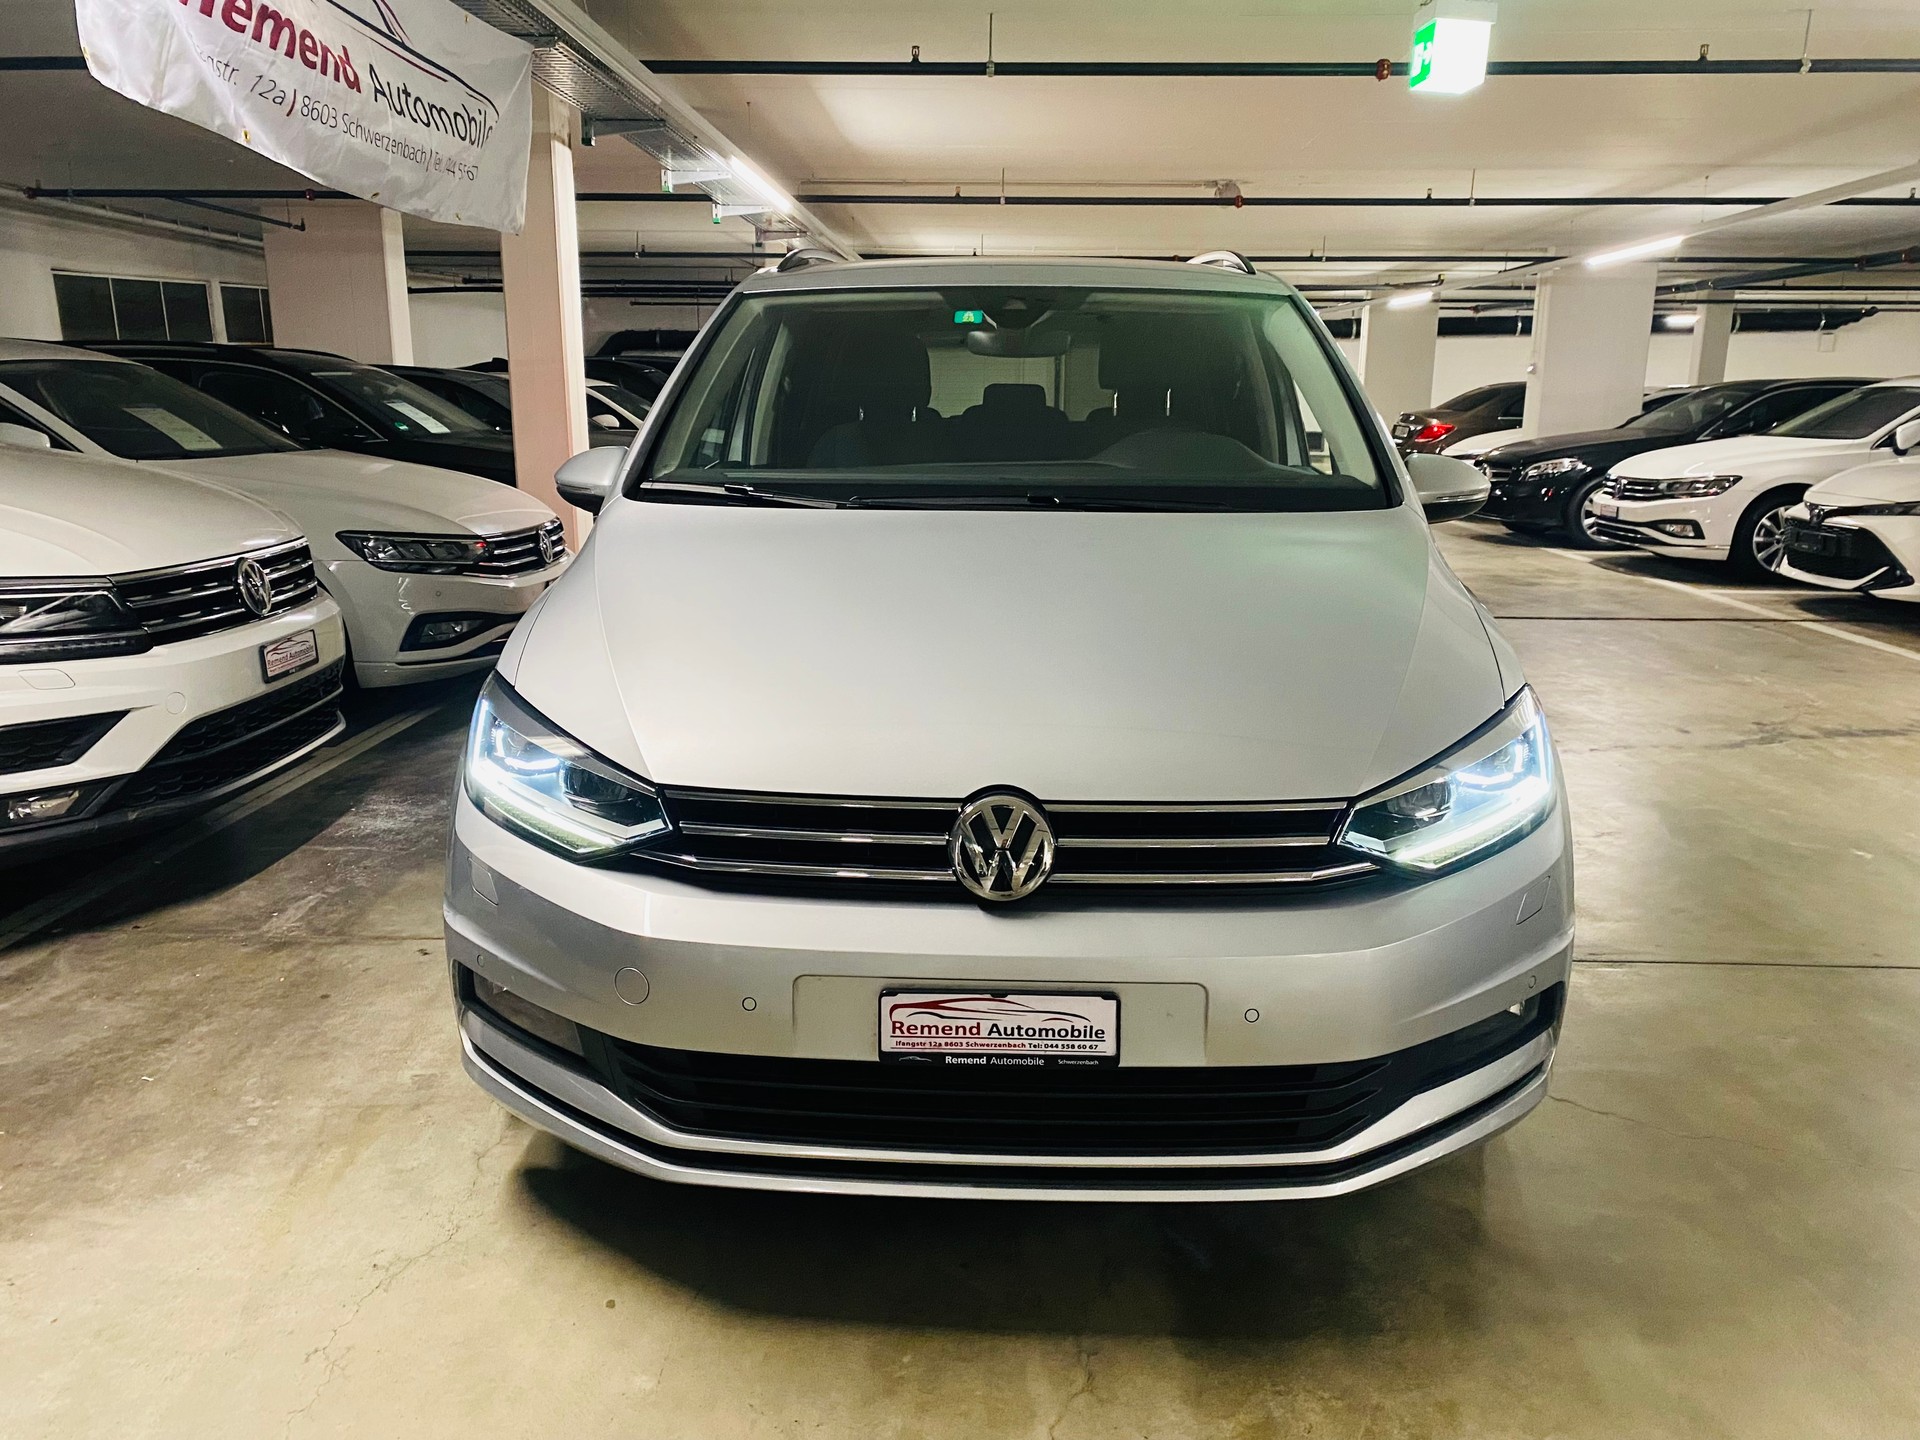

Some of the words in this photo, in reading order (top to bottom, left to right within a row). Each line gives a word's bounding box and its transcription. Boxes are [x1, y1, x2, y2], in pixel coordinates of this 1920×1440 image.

[178, 0, 362, 94] emend
[301, 95, 338, 128] 8603
[342, 113, 427, 165] Schwerzenbach
[891, 1020, 981, 1037] Remend
[987, 1023, 1106, 1039] Automobile
[895, 1040, 926, 1049] Ifangstr
[965, 1041, 1027, 1049] Schwerzenbach
[944, 1055, 987, 1065] Remend
[989, 1056, 1045, 1066] Automobile
